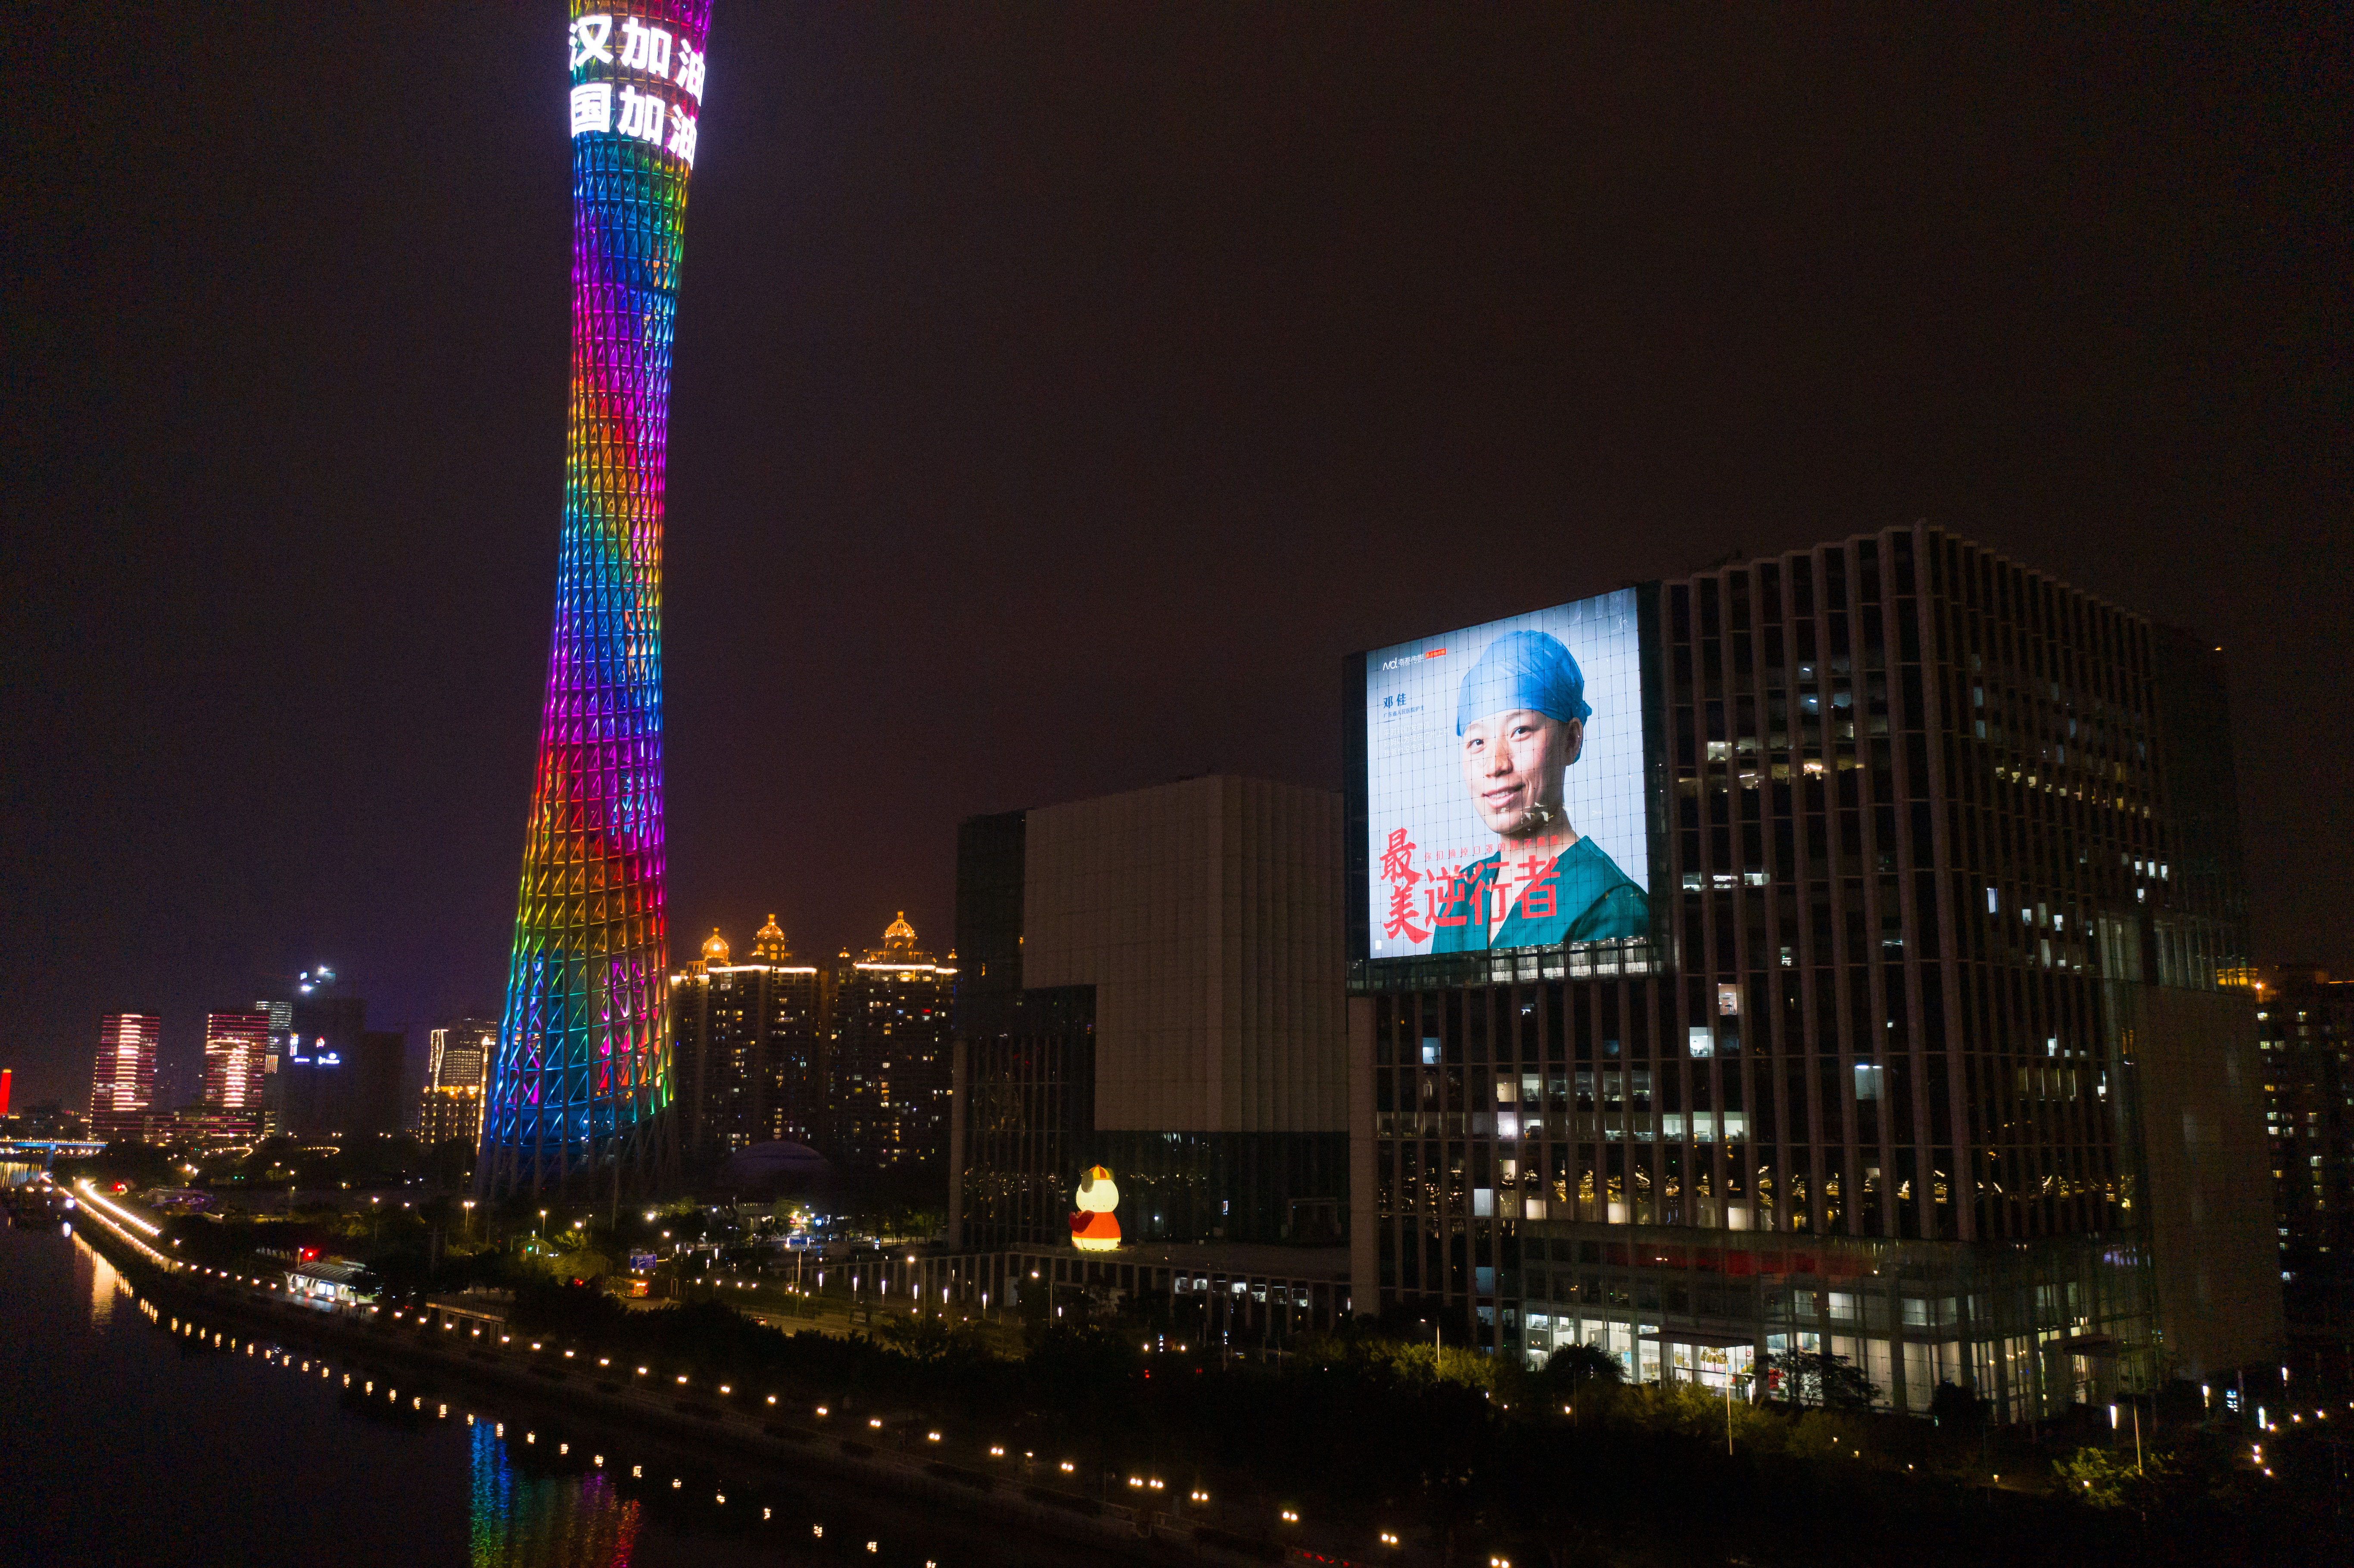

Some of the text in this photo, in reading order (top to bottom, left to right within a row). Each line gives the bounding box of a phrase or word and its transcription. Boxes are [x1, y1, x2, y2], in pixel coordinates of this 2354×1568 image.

[569, 15, 706, 106] 汉加油
[570, 83, 697, 170] 国加油
[1398, 653, 1424, 668] 南都传媒
[1384, 705, 1424, 718] 广东省人民医院护士
[1379, 828, 1433, 944] 最美
[1424, 854, 1560, 928] 逆行者
